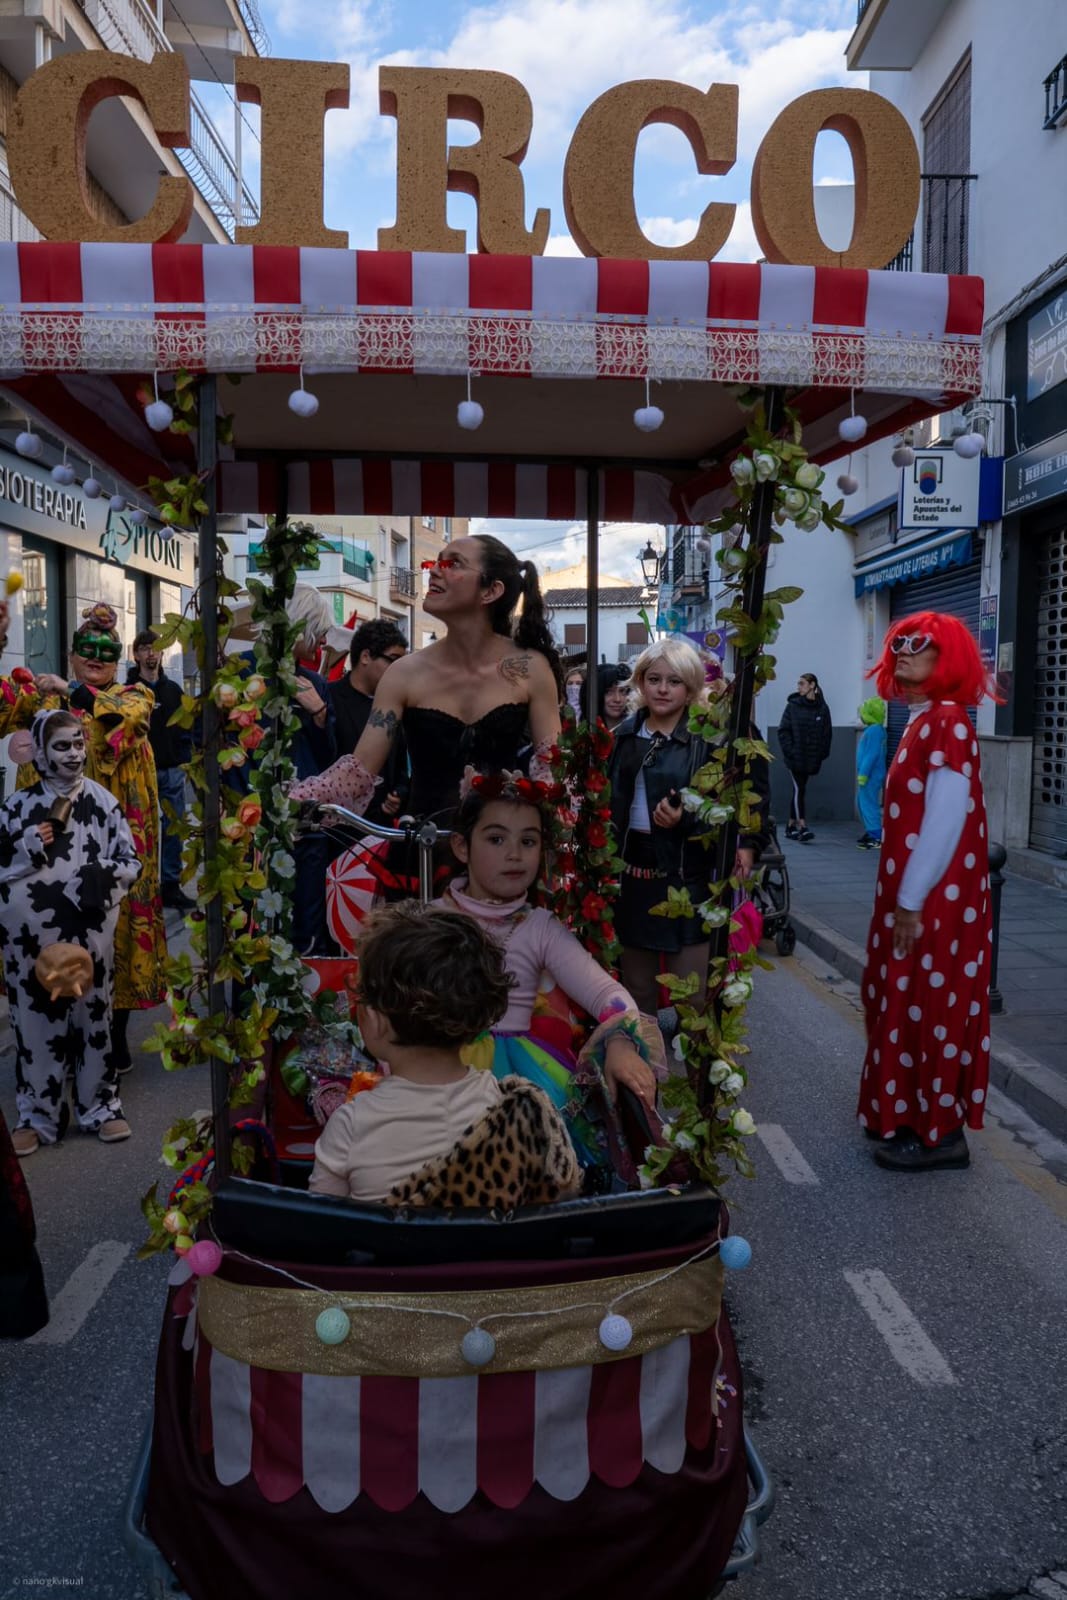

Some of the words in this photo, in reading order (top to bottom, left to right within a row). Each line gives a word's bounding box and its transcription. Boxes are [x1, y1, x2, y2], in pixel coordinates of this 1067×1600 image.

[7, 50, 921, 268] CIRCO
[913, 496, 944, 504] Loterías
[945, 497, 950, 505] y
[913, 505, 949, 514] Apuestas
[950, 504, 962, 513] del
[913, 513, 939, 521] Estado
